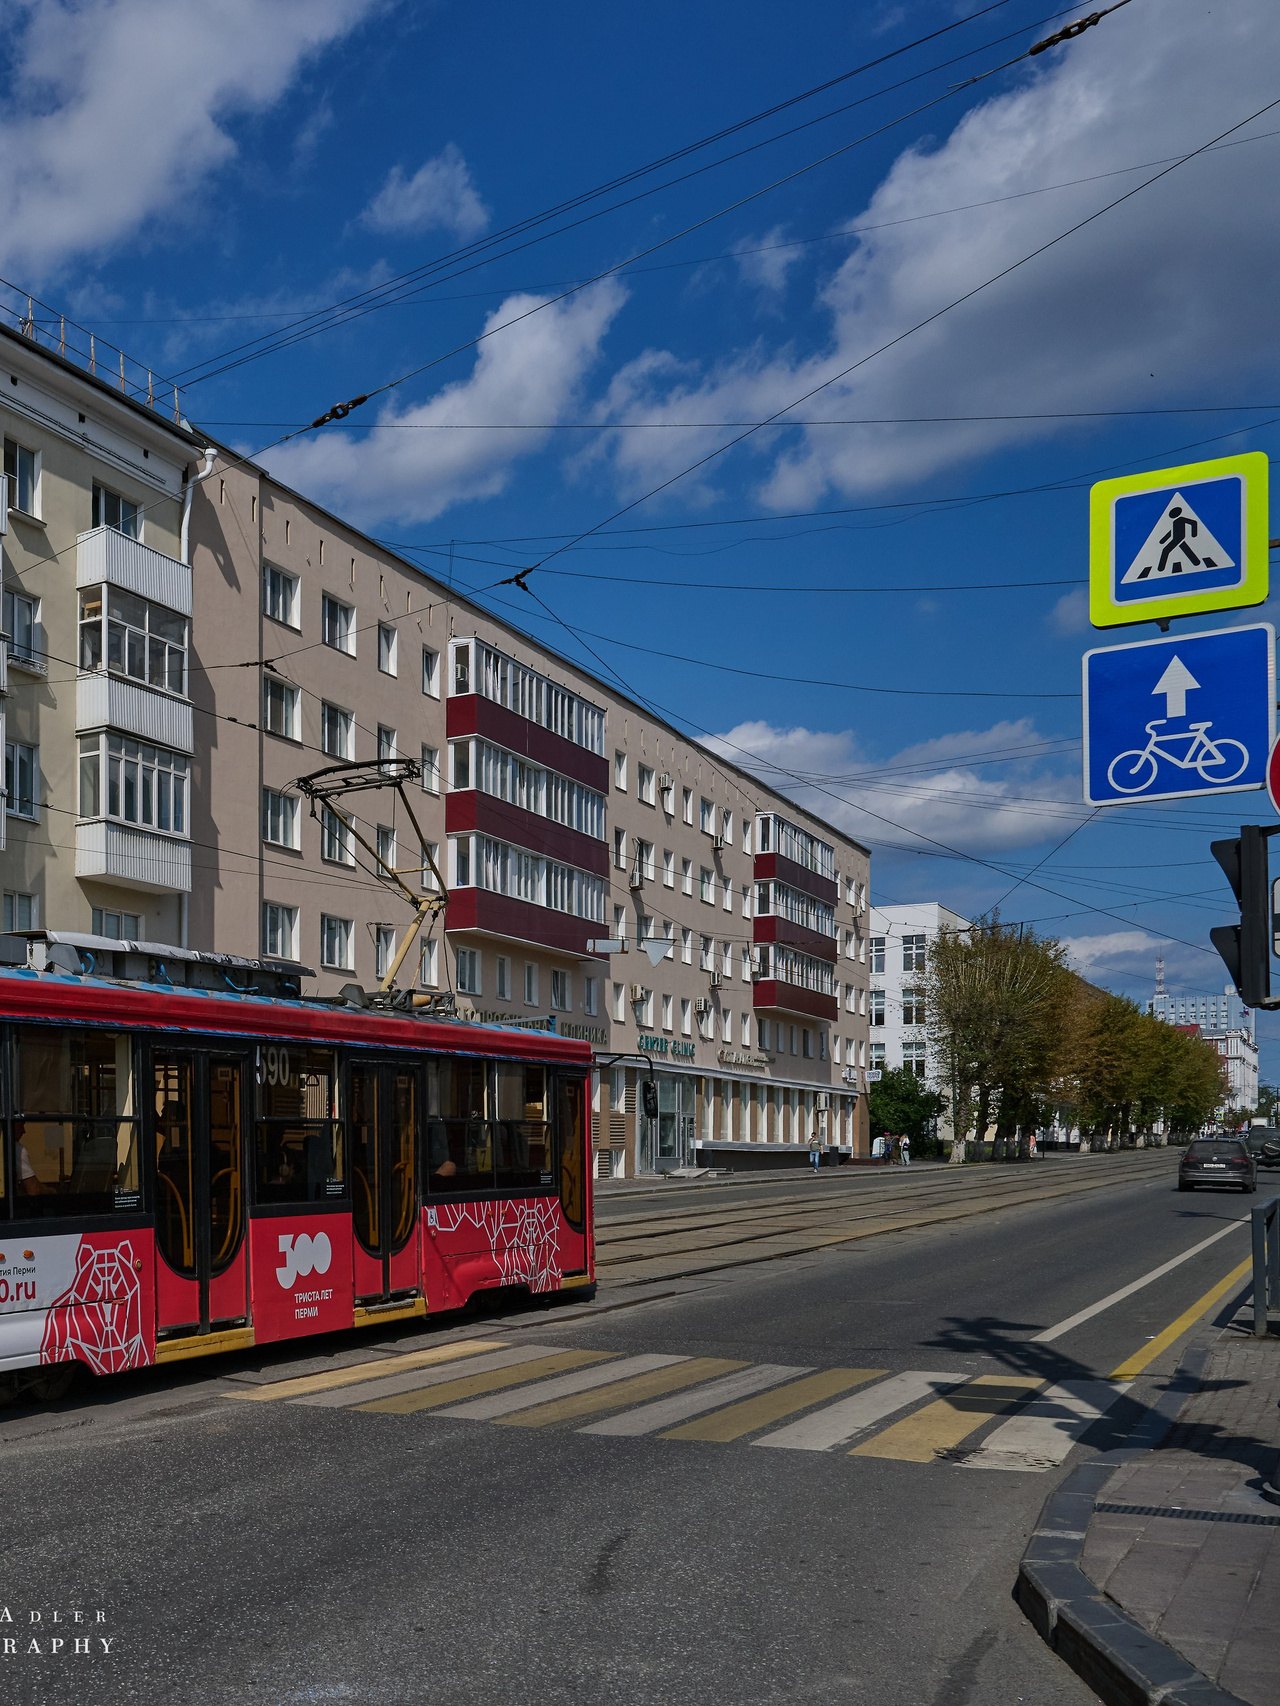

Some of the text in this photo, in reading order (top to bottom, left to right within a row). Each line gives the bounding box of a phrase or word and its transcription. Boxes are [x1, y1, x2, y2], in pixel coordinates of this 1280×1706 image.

[561, 1022, 608, 1045] КЛИНИКА
[671, 1040, 696, 1057] CLINIC
[480, 1149, 487, 1168] 7
[276, 1232, 332, 1289] 300
[13, 1266, 36, 1277] Перми
[294, 1289, 333, 1303] ТРИСТА ЛЕТ
[295, 1307, 318, 1319] ПЕРМИ
